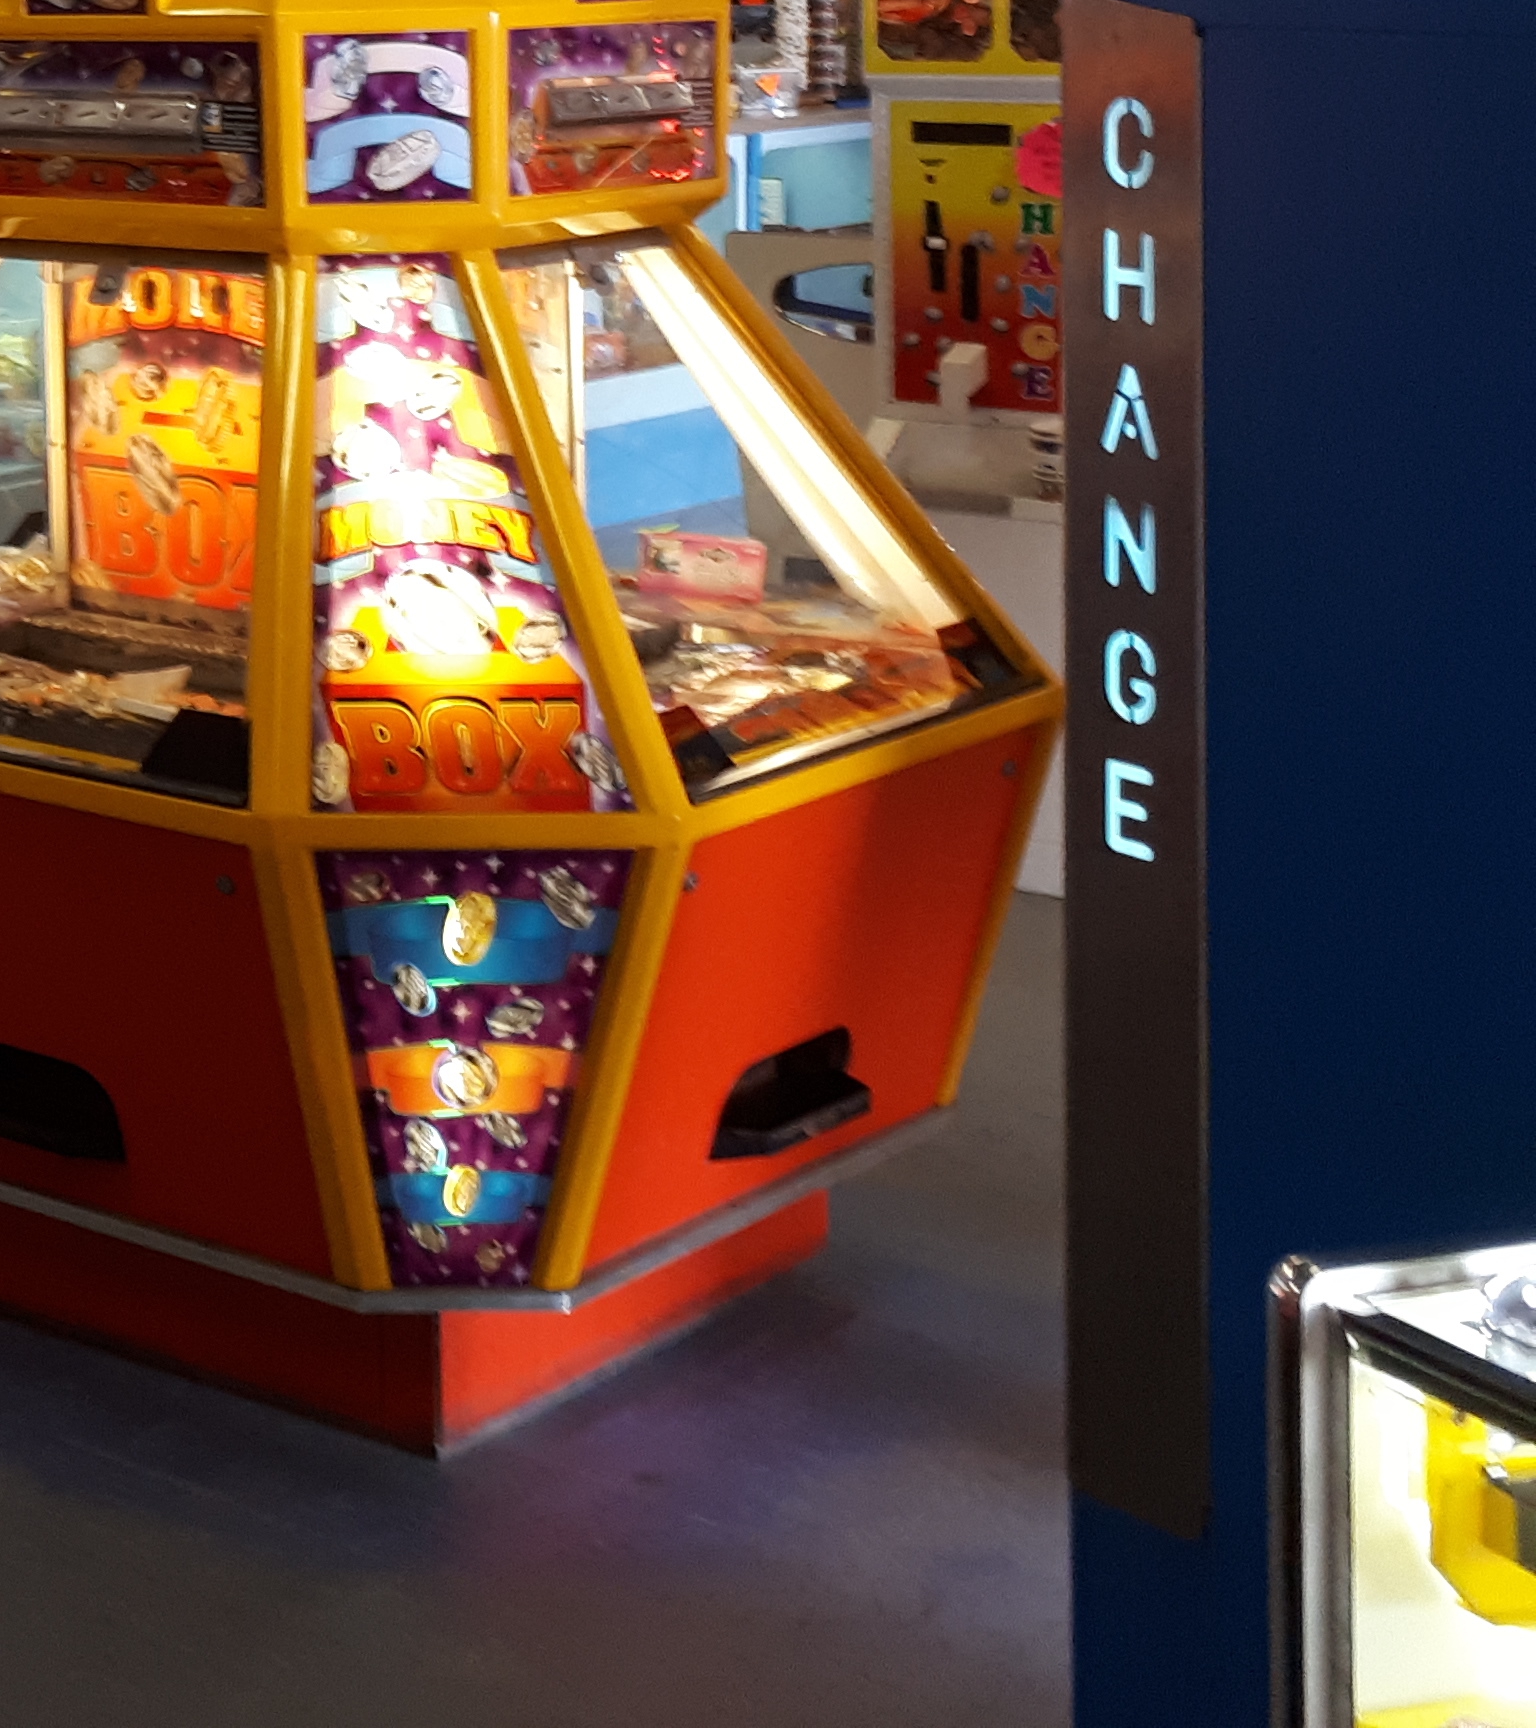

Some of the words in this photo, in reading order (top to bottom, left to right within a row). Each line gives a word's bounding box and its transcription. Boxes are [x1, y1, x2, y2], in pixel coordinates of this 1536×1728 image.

[70, 265, 265, 349] MONE
[1019, 201, 1060, 400] HANGE
[1100, 96, 1159, 863] CHANGE
[318, 498, 540, 565] MONEY
[331, 698, 592, 795] BOX
